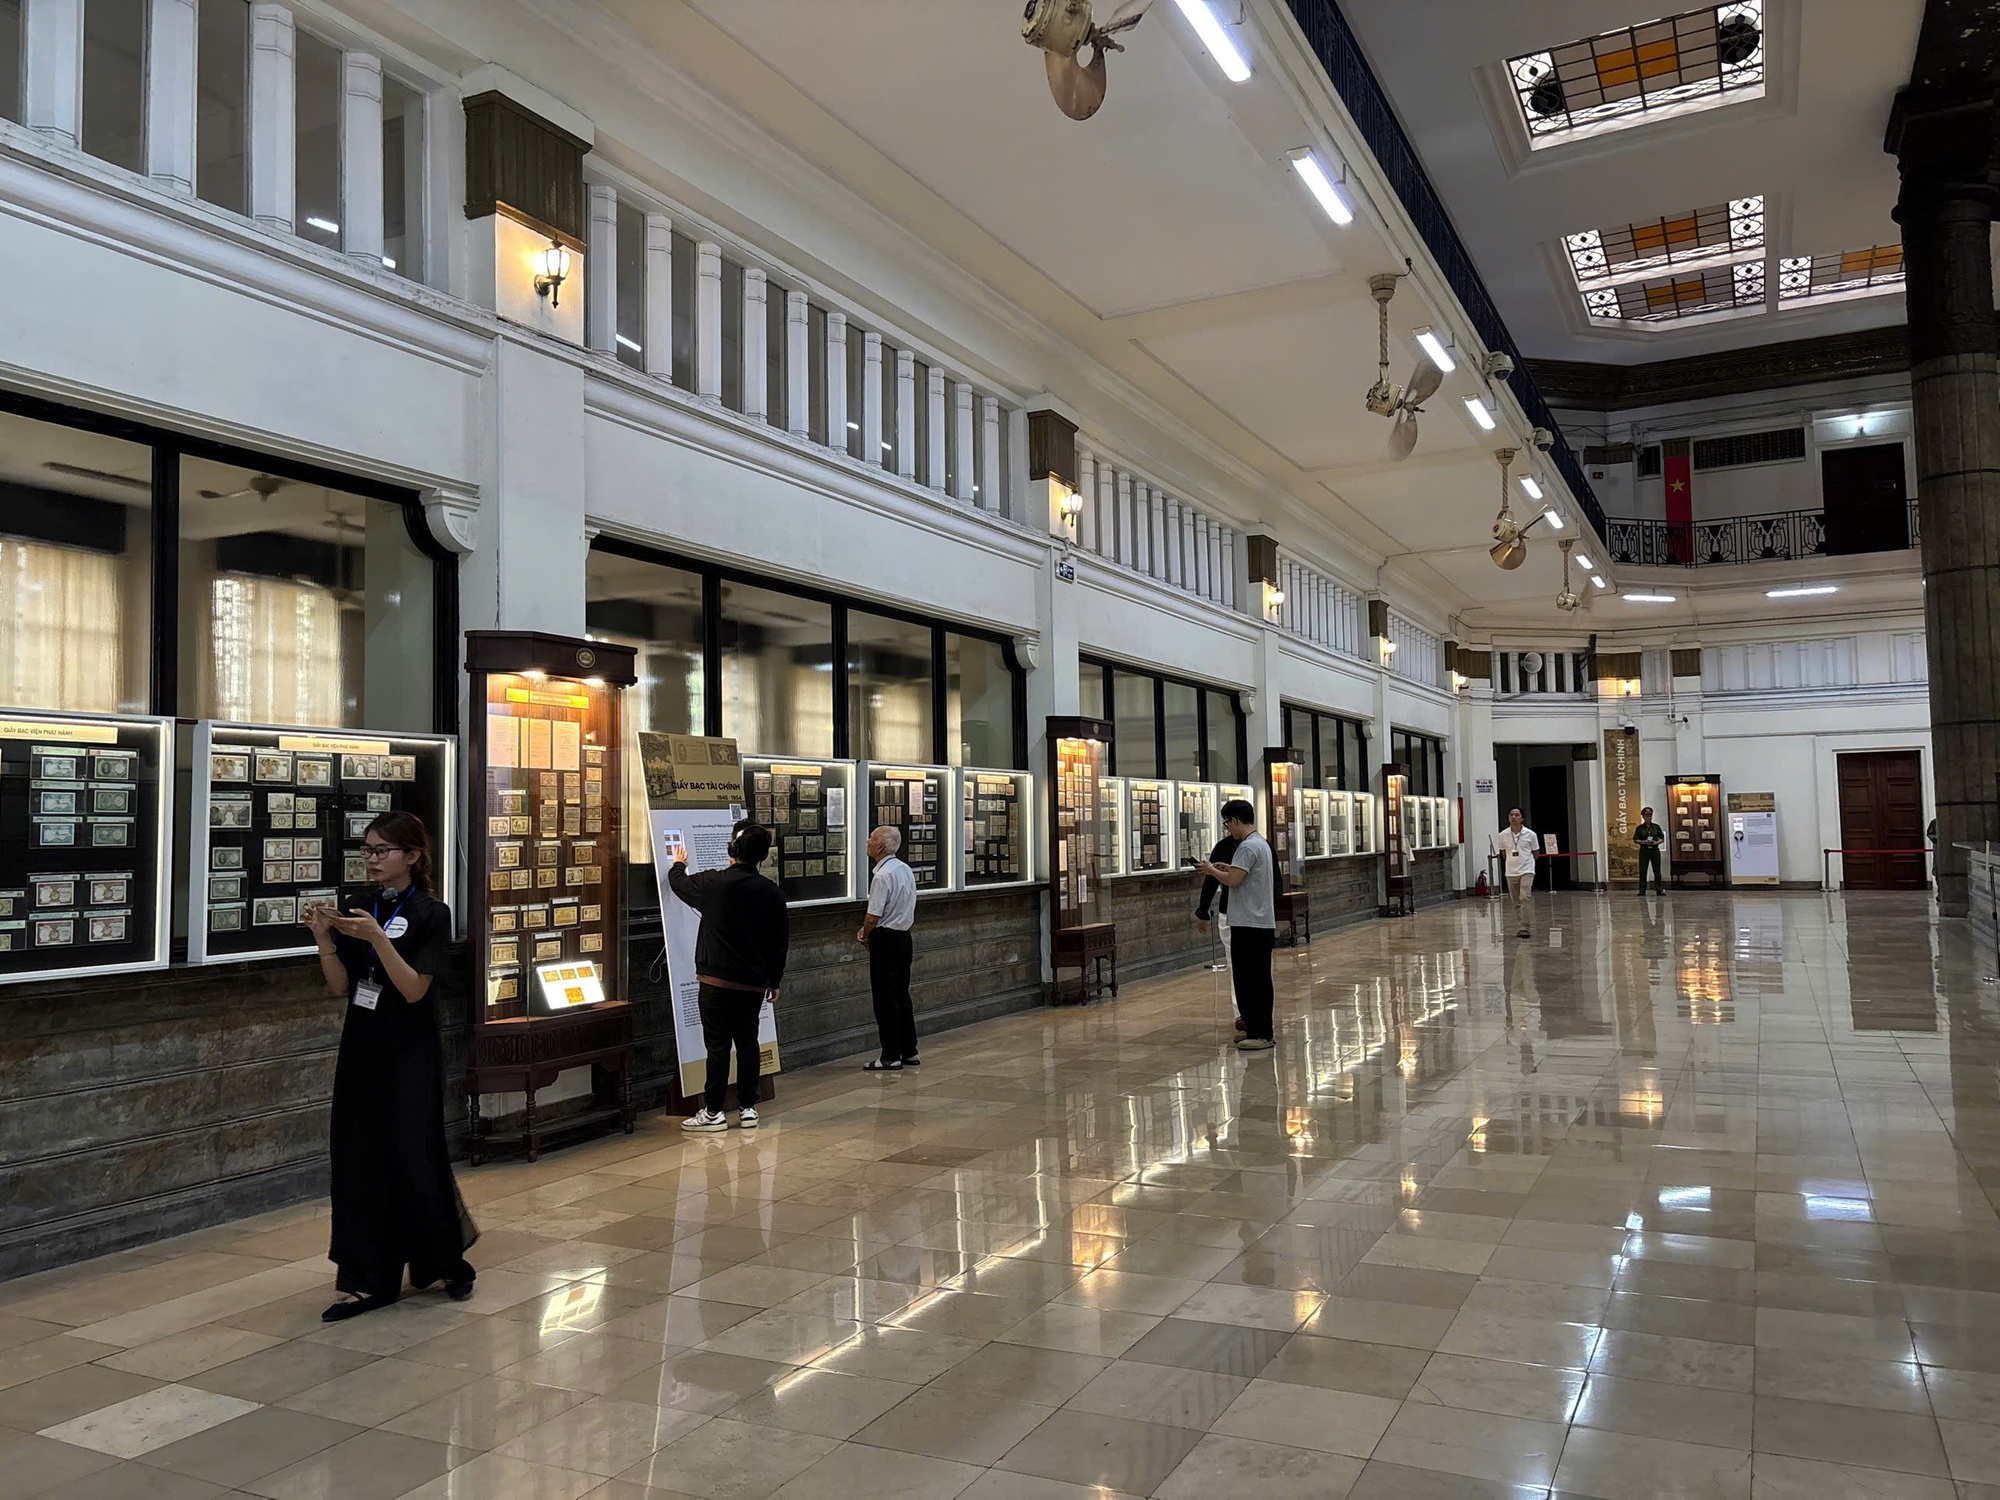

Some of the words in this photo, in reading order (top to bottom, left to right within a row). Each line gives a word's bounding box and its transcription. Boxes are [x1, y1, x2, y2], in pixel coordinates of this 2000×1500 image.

[1616, 739, 1625, 770] CHÍNH
[671, 779, 688, 790] GIẤY
[690, 782, 705, 792] BẠC
[706, 781, 717, 790] TÀI
[718, 781, 741, 791] CHÍNH
[1616, 772, 1626, 788] TÀI
[1618, 789, 1628, 809] BẠC
[1616, 810, 1627, 834] GIẤY
